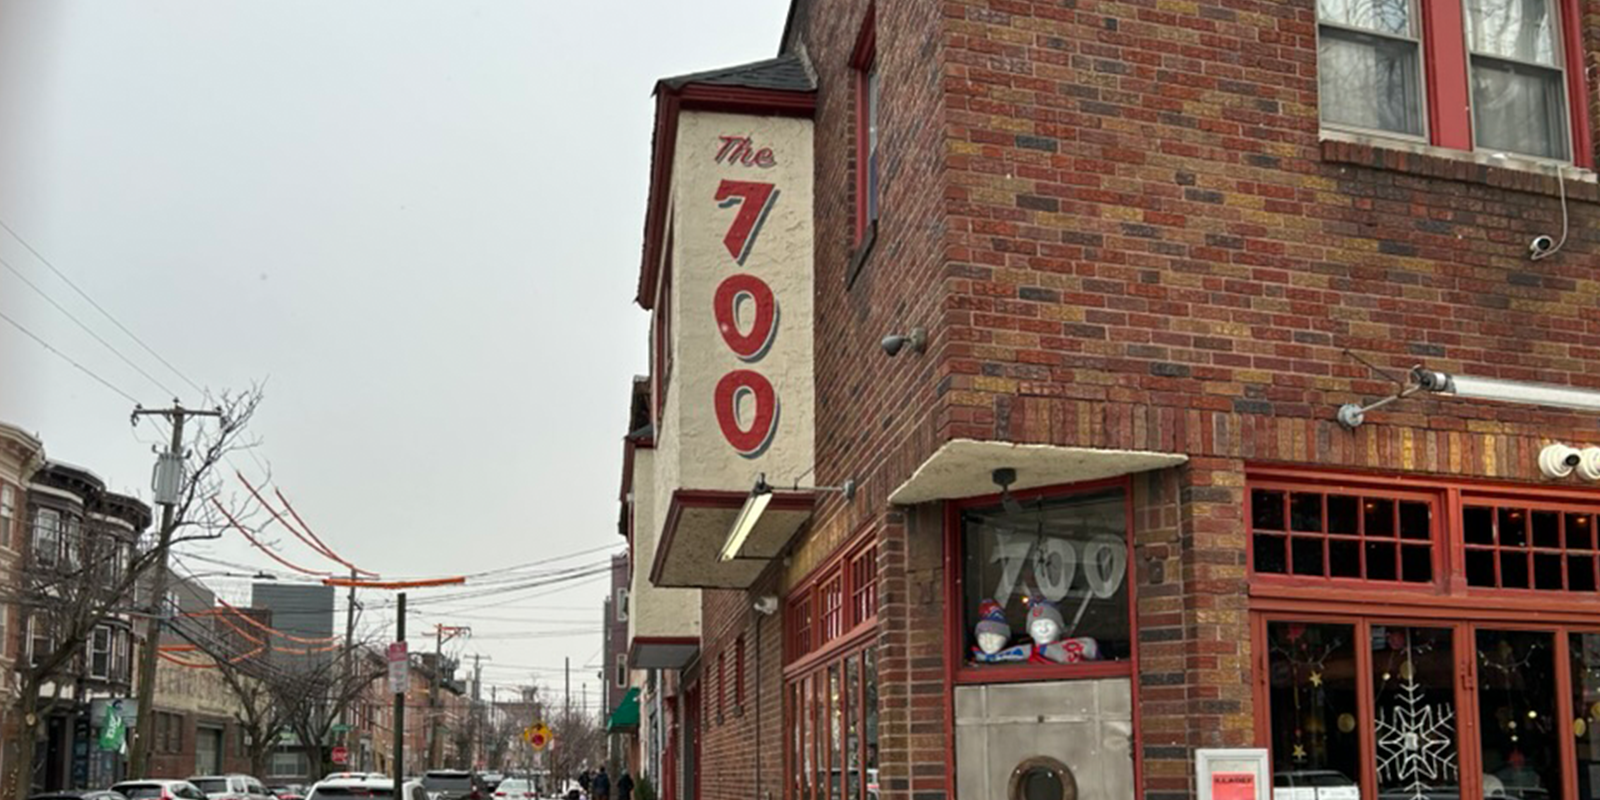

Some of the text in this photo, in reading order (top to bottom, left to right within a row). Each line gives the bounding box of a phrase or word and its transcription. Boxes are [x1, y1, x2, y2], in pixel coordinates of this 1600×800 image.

[714, 135, 777, 168] The
[713, 179, 780, 459] 700
[990, 529, 1127, 608] 700
